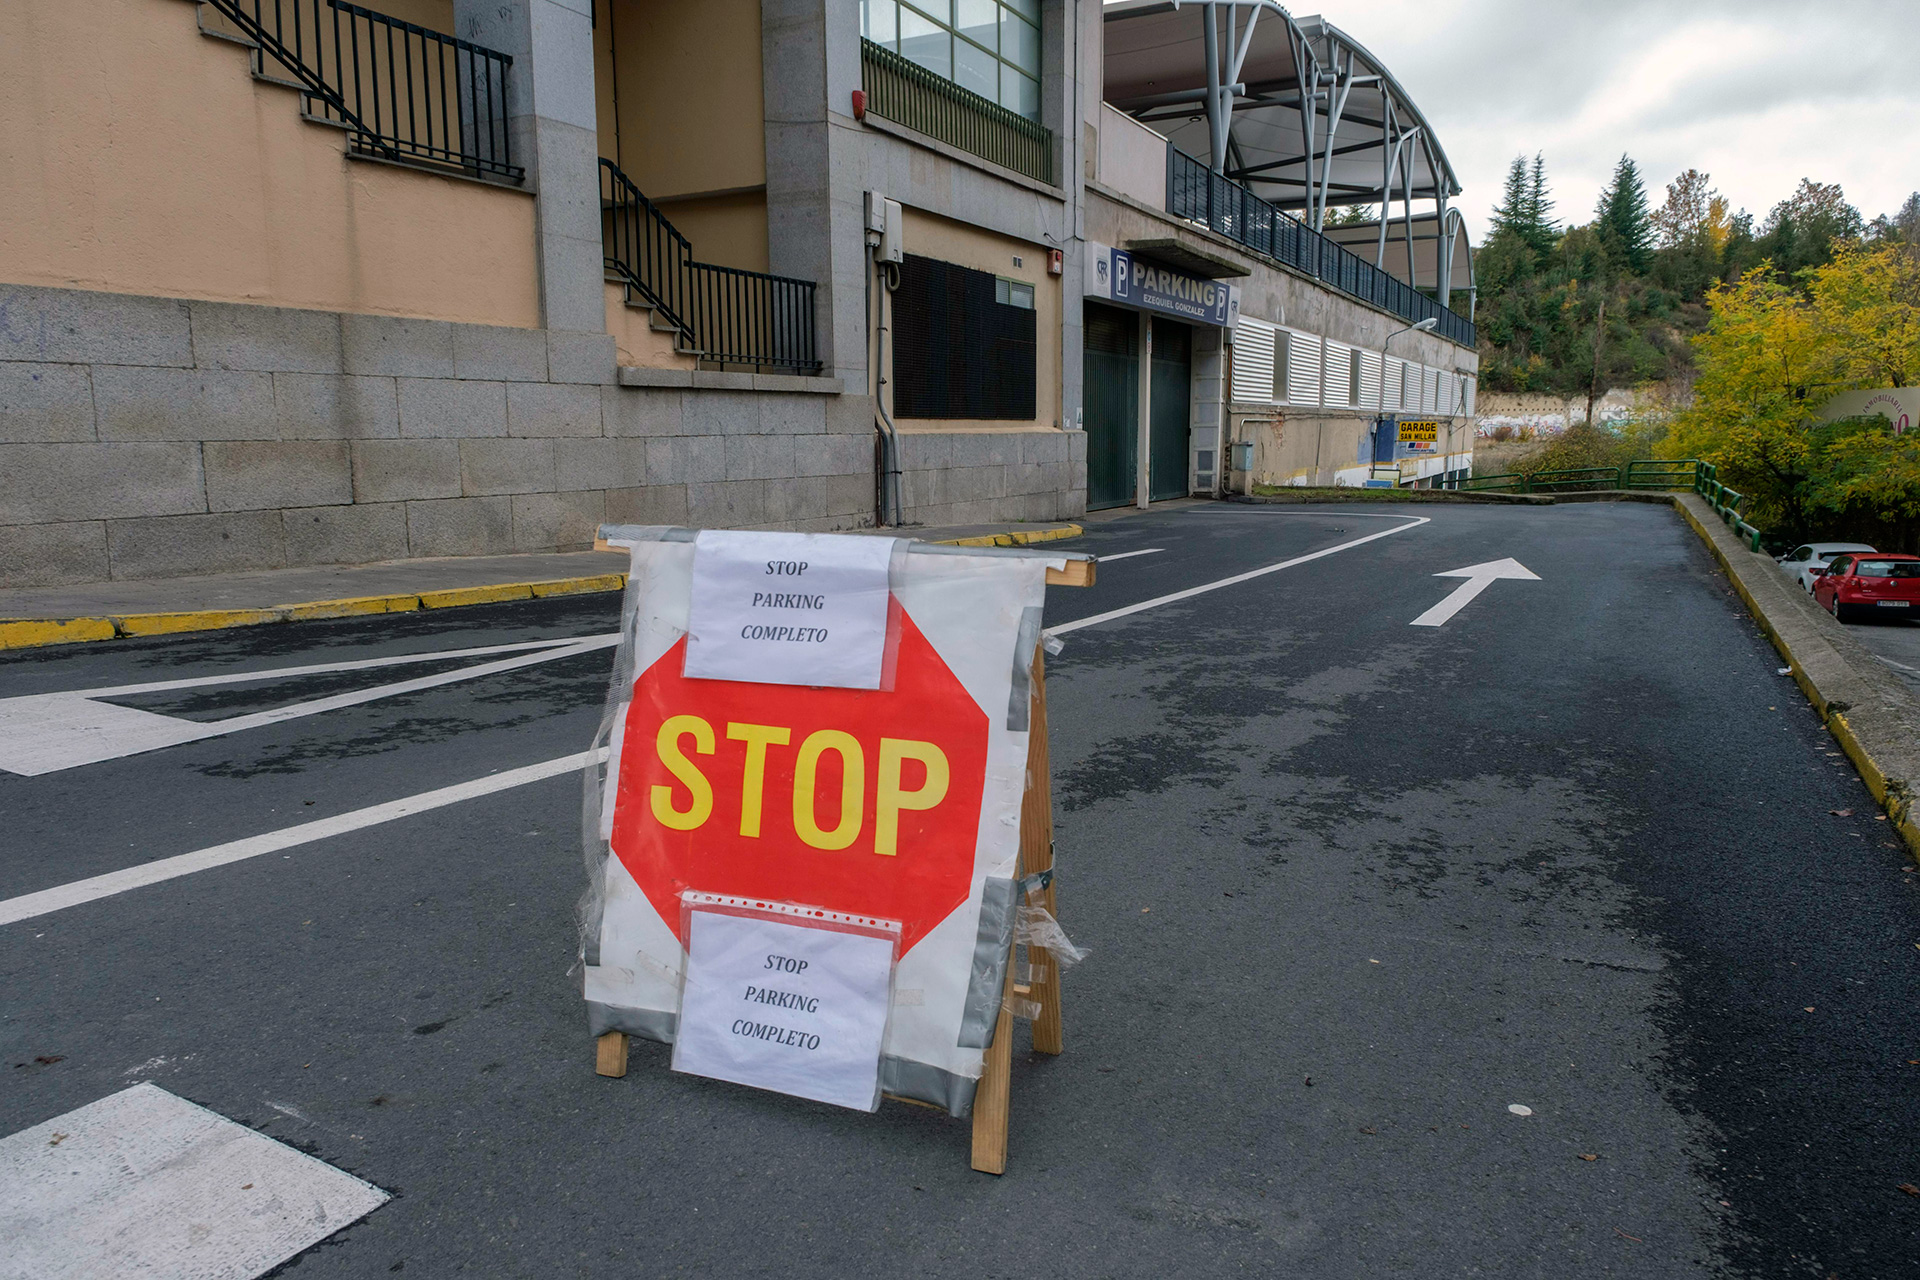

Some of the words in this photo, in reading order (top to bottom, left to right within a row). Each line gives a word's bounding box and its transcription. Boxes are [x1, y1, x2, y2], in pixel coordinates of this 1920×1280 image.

[1133, 262, 1215, 306] PARKING
[1143, 293, 1174, 309] EZEQUIEL
[1174, 302, 1205, 317] GONZALEZ
[1862, 394, 1903, 414] INMOBILIARIA
[1401, 422, 1436, 432] GARAGE
[765, 560, 809, 576] STOP
[752, 592, 825, 610] PARKING
[741, 624, 829, 643] COMPLETO
[649, 714, 951, 857] STOP
[763, 954, 809, 975] STOP
[743, 985, 820, 1014] PARKING
[731, 1019, 821, 1051] COMPLETO
